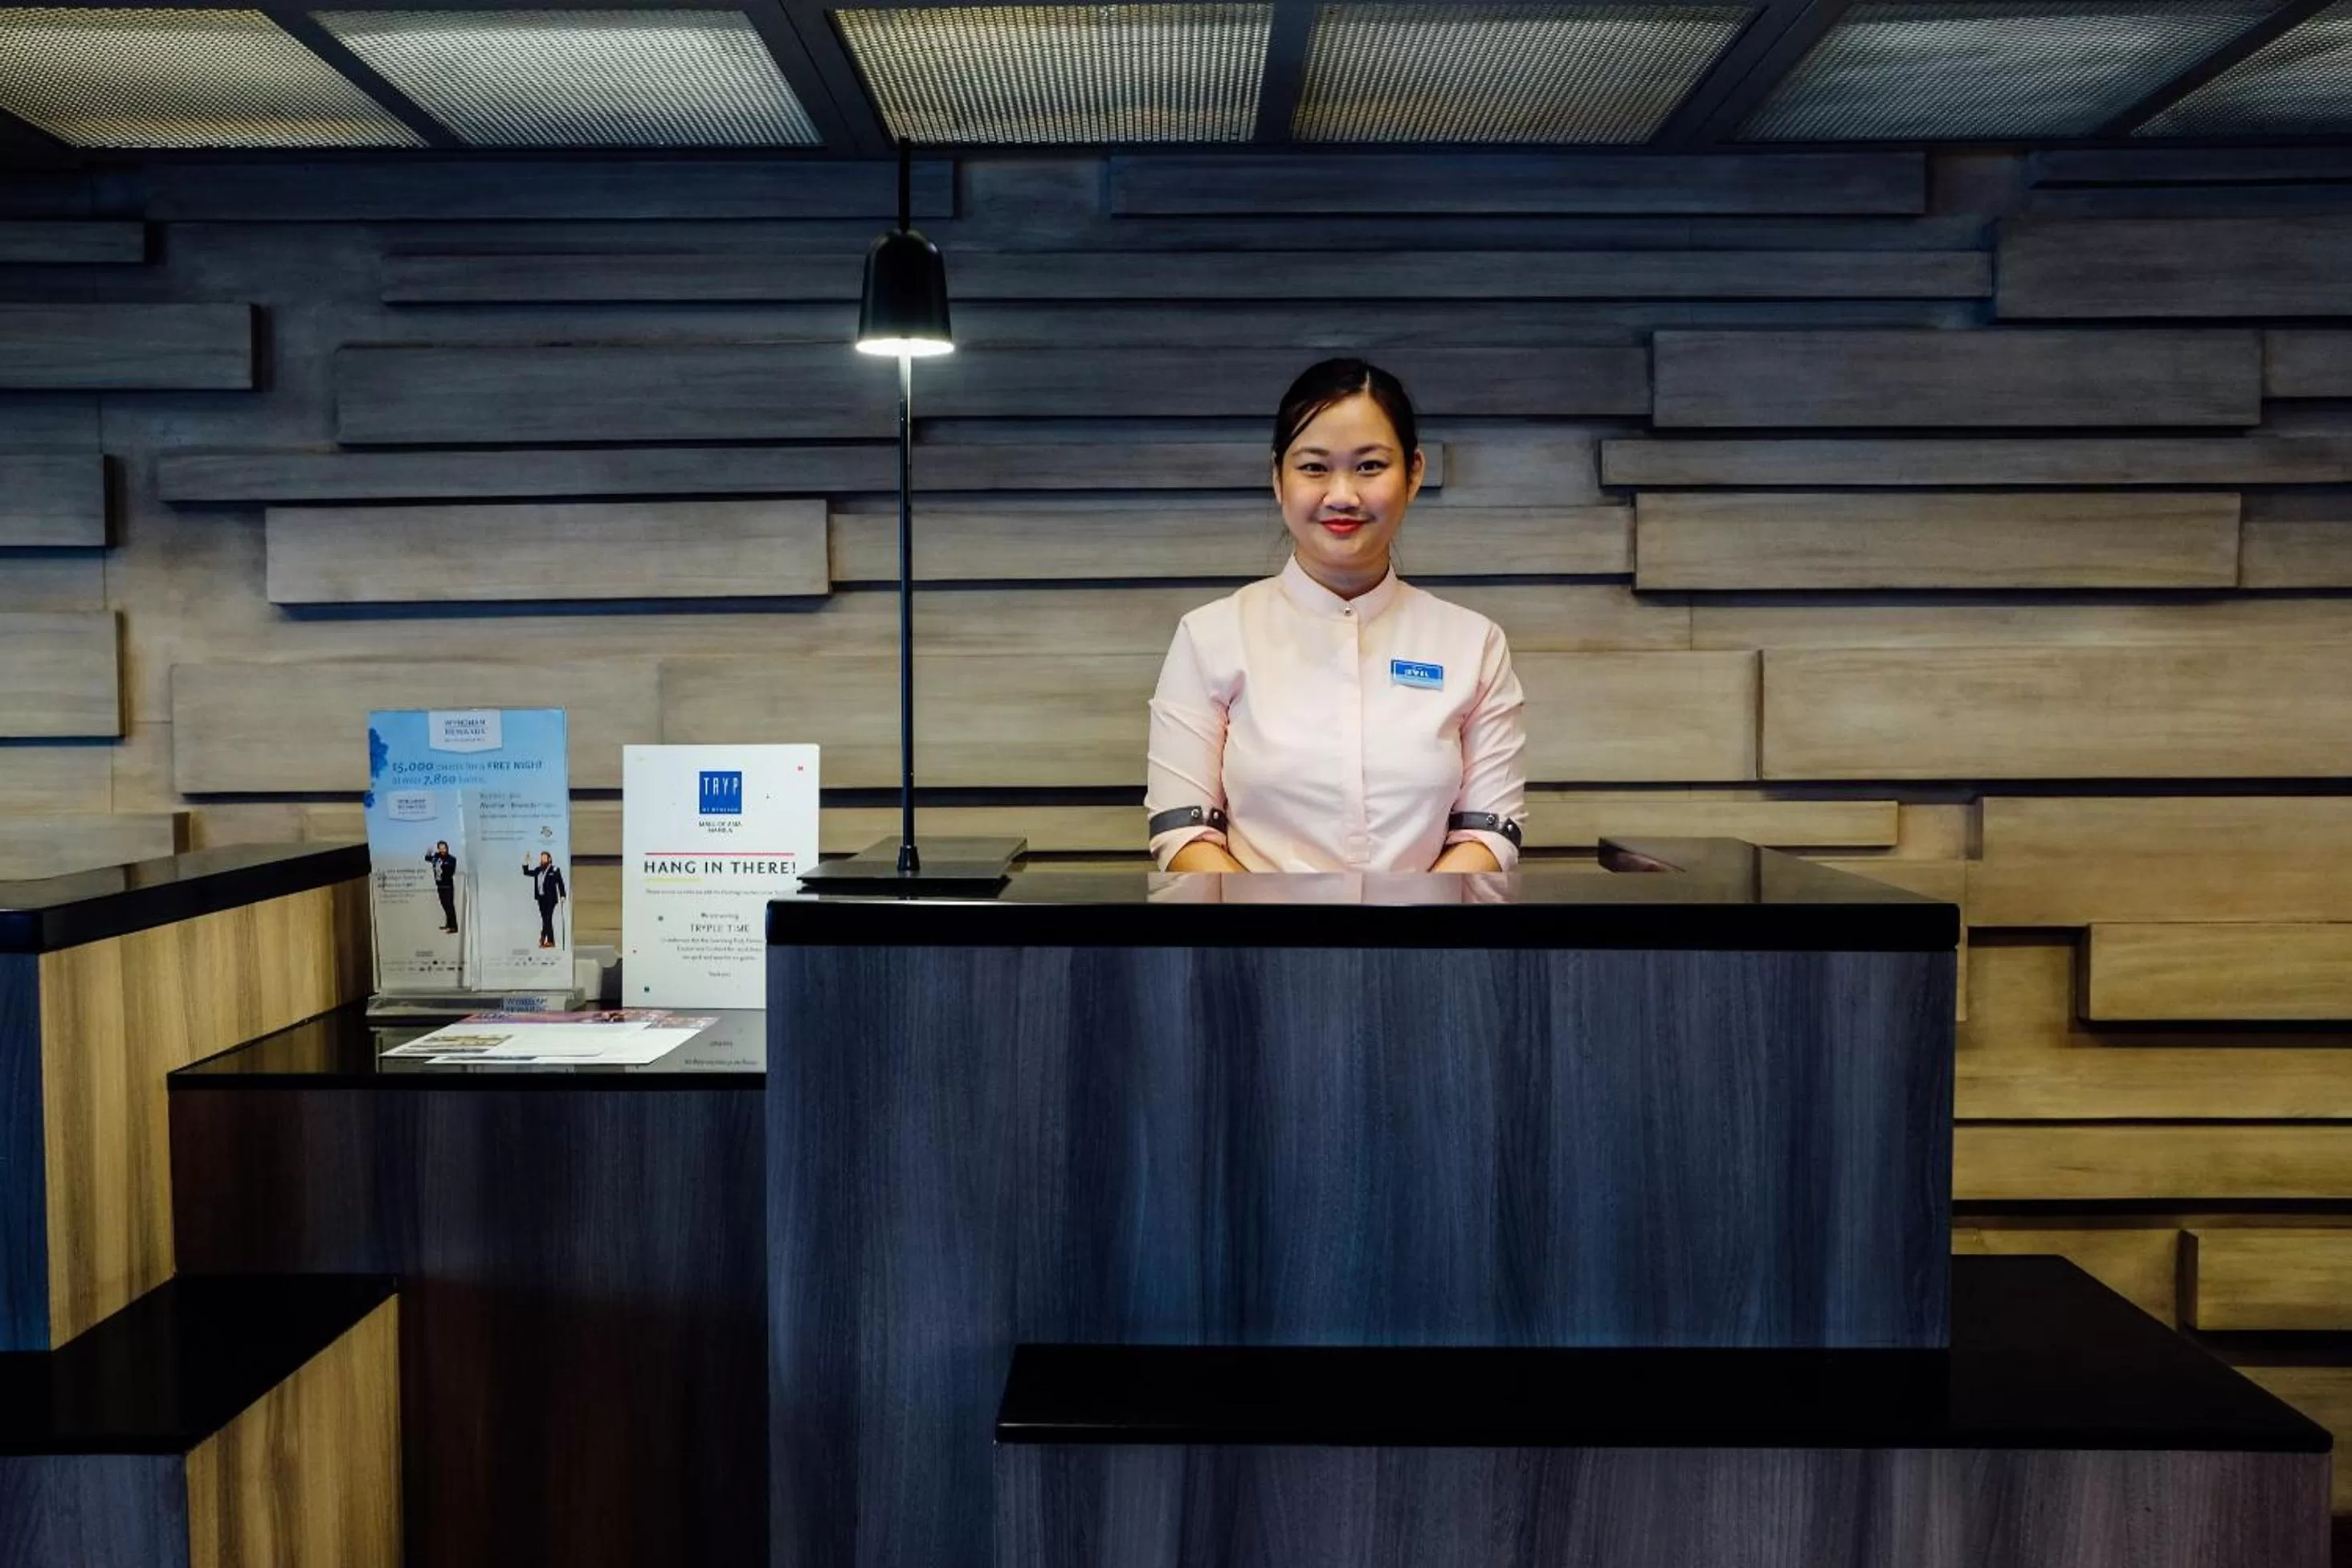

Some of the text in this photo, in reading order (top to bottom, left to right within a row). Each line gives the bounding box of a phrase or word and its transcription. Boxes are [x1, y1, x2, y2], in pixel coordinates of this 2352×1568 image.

[703, 777, 740, 797] TRYP
[643, 861, 796, 874] HANG IN THERE!
